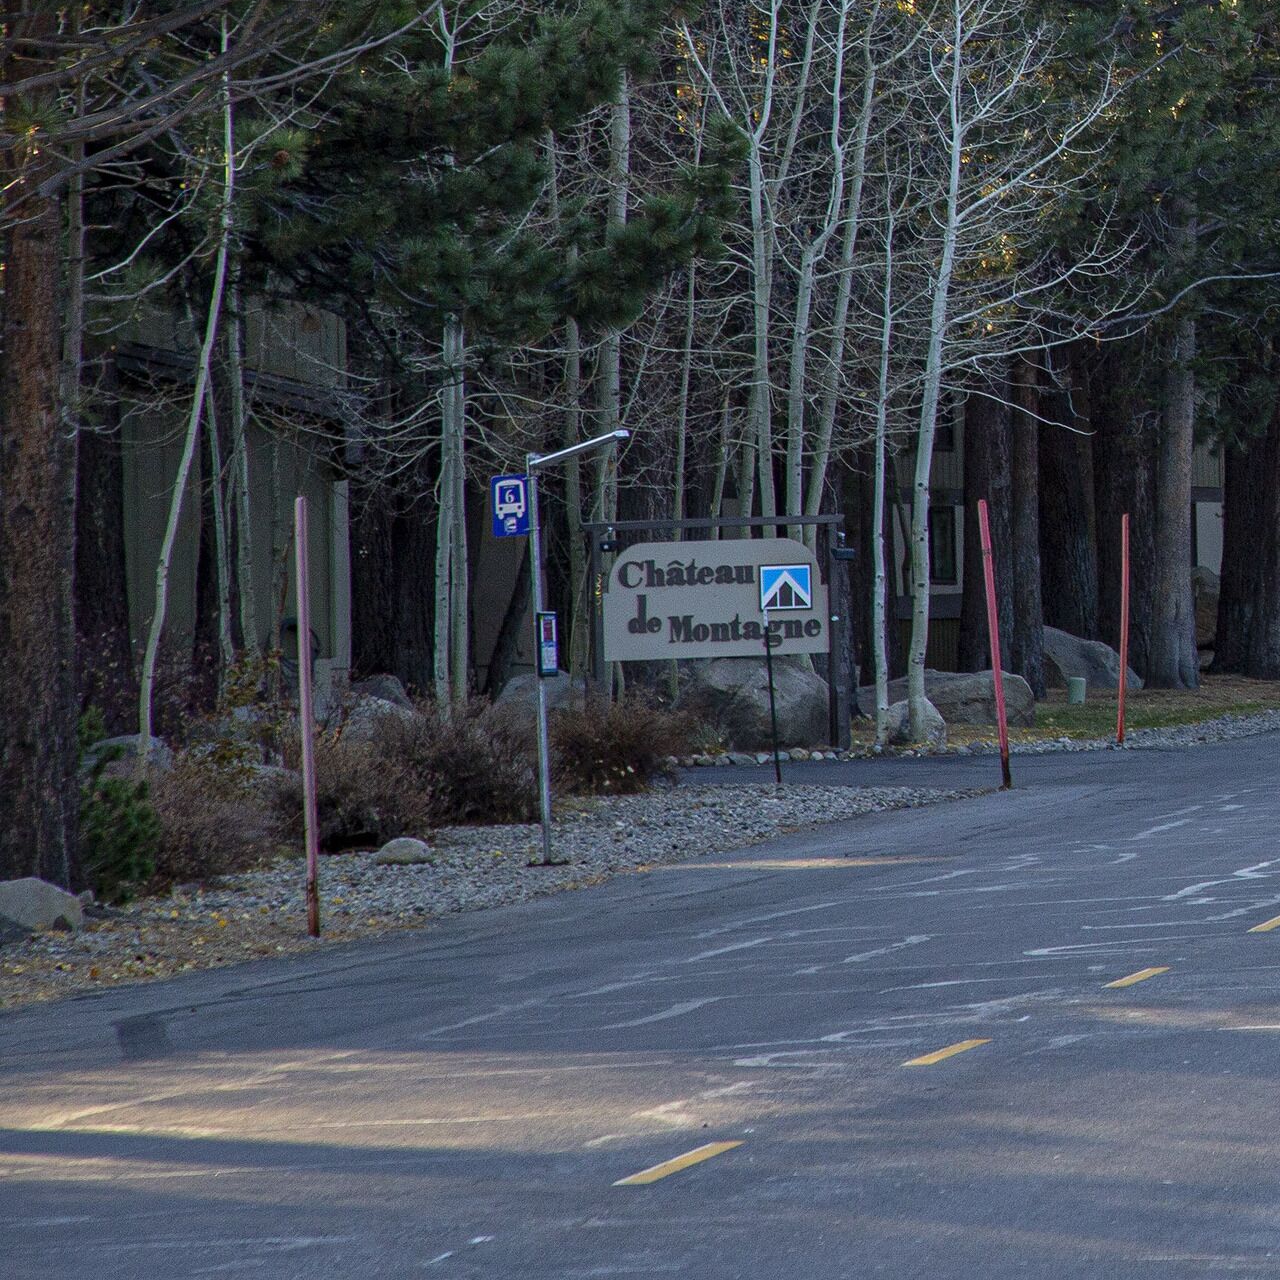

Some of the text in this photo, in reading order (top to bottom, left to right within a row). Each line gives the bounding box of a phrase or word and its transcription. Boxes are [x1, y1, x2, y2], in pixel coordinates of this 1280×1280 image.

[505, 489, 515, 504] 6
[617, 558, 755, 589] Château
[627, 594, 822, 649] de Montagne
